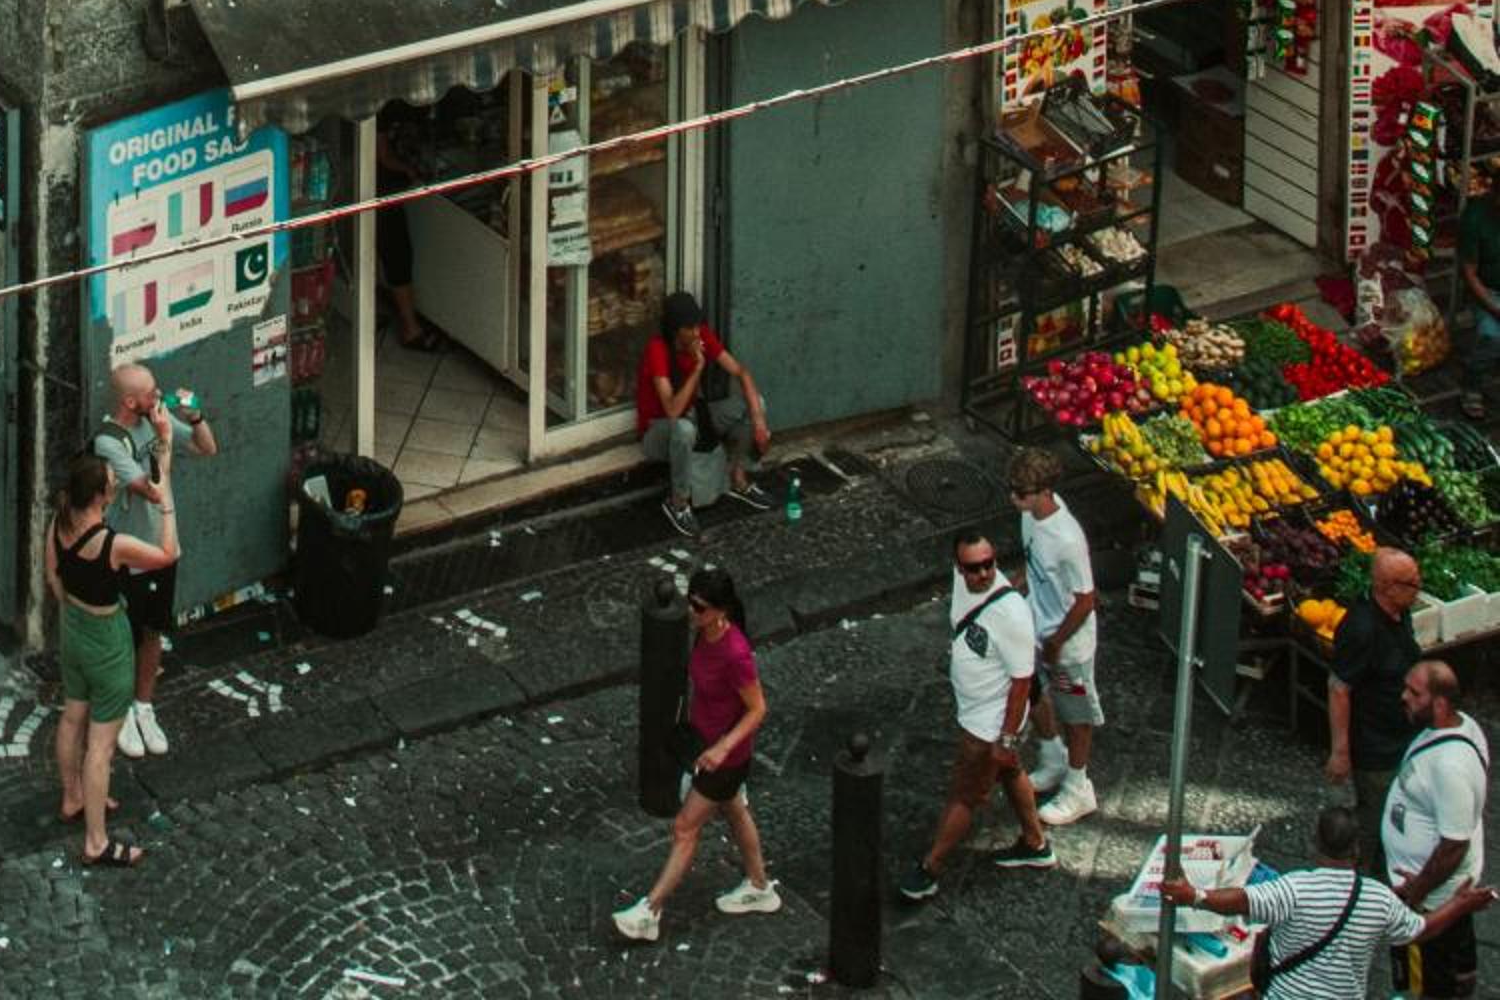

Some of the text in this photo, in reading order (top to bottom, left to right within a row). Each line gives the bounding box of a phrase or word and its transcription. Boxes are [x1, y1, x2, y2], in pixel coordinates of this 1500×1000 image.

[108, 112, 220, 166] ORIGINAL
[132, 147, 198, 188] FOOD
[179, 315, 203, 331] India
